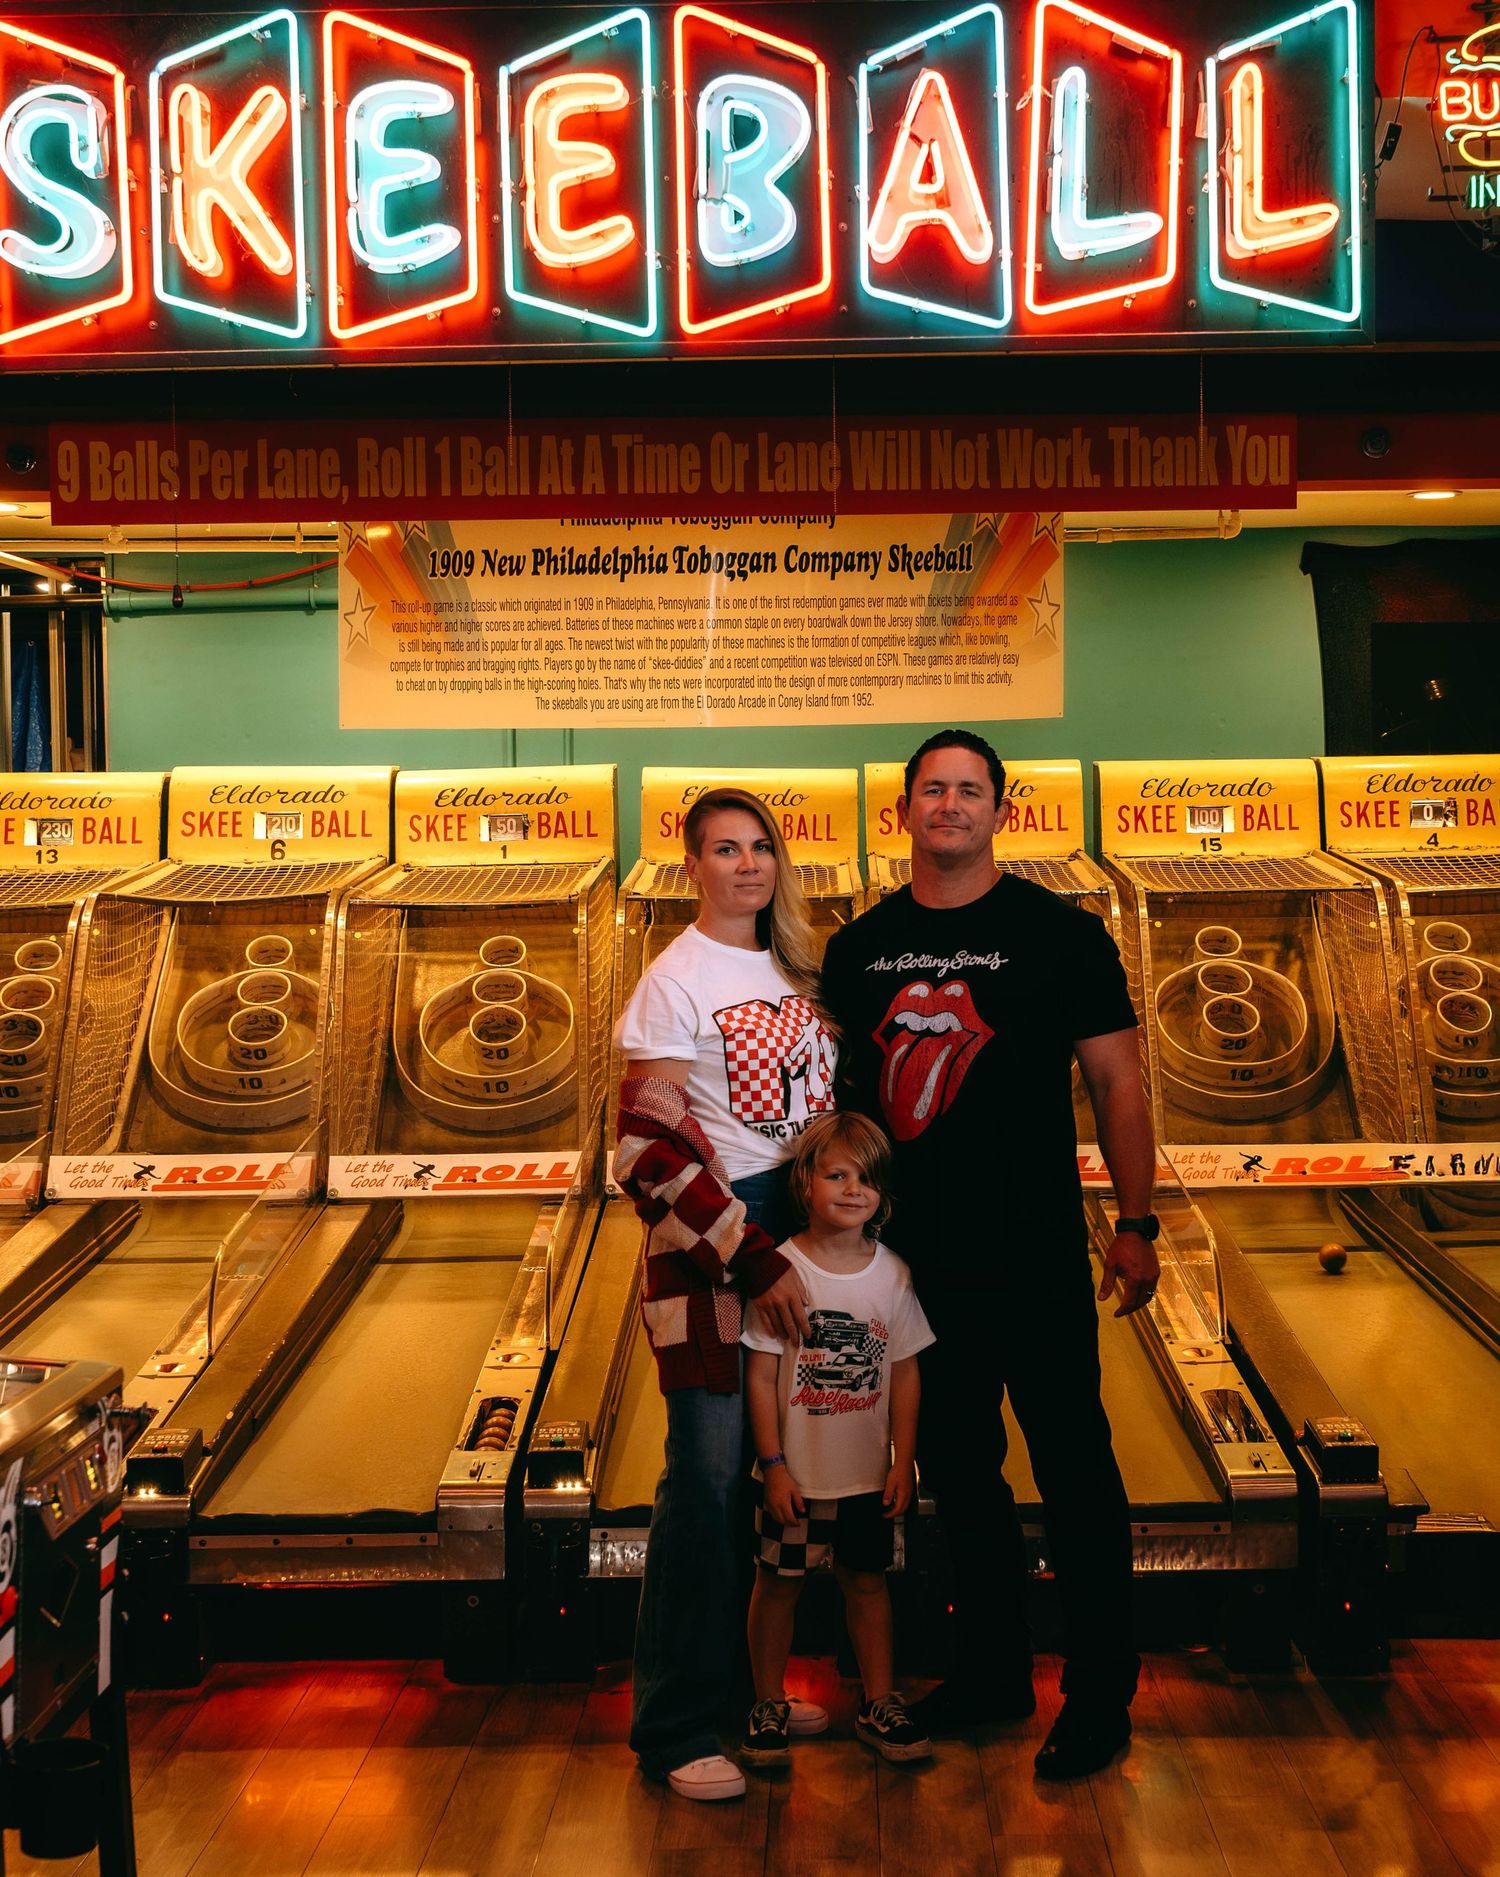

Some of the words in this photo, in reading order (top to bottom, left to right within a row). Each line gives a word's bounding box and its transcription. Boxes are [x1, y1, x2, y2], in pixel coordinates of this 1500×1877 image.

[0, 62, 1340, 279] SKEEBALL
[58, 440, 79, 502] 9
[89, 440, 180, 502] Balls
[190, 439, 247, 500] Per
[258, 439, 348, 504] Lane,
[358, 437, 426, 498] Roll
[436, 437, 450, 496] 1
[461, 436, 529, 496] Ball
[538, 436, 574, 495] At
[582, 435, 604, 494] A
[612, 434, 700, 494] Time
[710, 432, 748, 493] Or
[758, 432, 840, 492] Lane
[850, 430, 920, 490] Will
[931, 430, 990, 490] Not
[998, 428, 1100, 489] Work.
[1109, 425, 1218, 487] Thank
[1226, 424, 1289, 486] You
[429, 548, 474, 578] 1909
[481, 548, 525, 577] New
[531, 545, 668, 583] Philadelphia
[672, 544, 776, 581] Toboggan
[784, 544, 881, 580] Company
[888, 541, 972, 578] Skeeball
[390, 658, 421, 674] compete
[422, 658, 433, 671] for
[434, 658, 464, 674] trophies
[466, 658, 480, 671] and
[482, 657, 515, 674] bragging
[517, 657, 541, 673] rights.
[544, 656, 572, 673] Players
[574, 659, 585, 673] go
[586, 656, 596, 673] by
[598, 656, 611, 670] the
[613, 659, 635, 670] name
[637, 656, 646, 670] of
[709, 655, 724, 669] and
[726, 658, 731, 669] a
[733, 655, 759, 669] recent
[760, 654, 807, 671] competition
[809, 656, 826, 667] was
[828, 654, 862, 667] televised
[864, 656, 874, 667] on
[876, 652, 900, 667] ESPN.
[902, 652, 926, 666] These
[927, 654, 953, 668] games
[954, 654, 967, 665] are
[968, 651, 1001, 668] relatively
[1002, 653, 1019, 667] easy
[396, 678, 403, 691] to
[405, 678, 425, 691] cheat
[426, 680, 436, 691] on
[438, 678, 448, 694] by
[449, 678, 482, 694] dropping
[484, 677, 502, 691] balls
[504, 677, 511, 690] in
[513, 677, 525, 690] the
[527, 676, 575, 693] high-scoring
[577, 676, 601, 690] holes.
[603, 676, 627, 690] That's
[629, 676, 646, 692] why
[648, 675, 661, 689] the
[663, 676, 680, 689] nets
[682, 678, 702, 689] were
[704, 674, 754, 691] incorporated
[757, 674, 772, 688] into
[774, 674, 786, 688] the
[788, 674, 815, 690] design
[817, 673, 825, 687] of
[827, 676, 848, 687] more
[849, 673, 904, 689] contemporary
[905, 672, 942, 686] machines
[944, 672, 952, 685] to
[953, 672, 969, 684] limit
[970, 672, 984, 684] this
[986, 671, 1013, 686] activity.
[706, 694, 735, 708] Dorado
[737, 694, 766, 708] Arcade
[778, 694, 803, 710] Coney
[805, 693, 828, 707] Island
[1140, 777, 1277, 799] Eldorado
[1366, 773, 1496, 794] Eldorado
[0, 791, 114, 810] ldorado
[209, 784, 349, 804] Eldorado
[434, 786, 572, 808] Eldorado
[1009, 804, 1069, 833] BALL
[1118, 805, 1177, 833] SKEE
[1243, 804, 1300, 832] BALL
[1194, 810, 1219, 825] 100
[1340, 801, 1400, 828] SKEE
[1423, 805, 1434, 821] 0
[41, 822, 72, 838] 230
[82, 816, 143, 845] BALL
[181, 811, 243, 838] SKEE
[311, 810, 373, 837] BALL
[271, 817, 296, 832] 210
[409, 814, 467, 842] SKEE
[537, 810, 598, 838] BALL
[495, 818, 517, 833] 50
[783, 814, 837, 841] BALL
[1200, 838, 1222, 852] 15
[1427, 833, 1439, 847] 4
[36, 849, 58, 864] 13
[271, 839, 286, 860] 6
[500, 845, 507, 859] 1
[892, 953, 951, 977] Rolling
[950, 950, 1008, 970] Stones
[1221, 1038, 1247, 1050] 20
[240, 1047, 267, 1060] 20
[482, 1047, 509, 1060] 20
[239, 1077, 263, 1089] 10
[1231, 1069, 1254, 1081] 10
[483, 1081, 509, 1093] 10
[1173, 1152, 1197, 1164] Let
[1200, 1152, 1221, 1164] the
[64, 1162, 89, 1174] Let
[91, 1161, 115, 1173] the
[345, 1161, 370, 1173] Let
[373, 1160, 394, 1172] the
[442, 1162, 575, 1183] ROLL
[1182, 1166, 1216, 1180] Good
[1222, 1166, 1260, 1179] Times
[69, 1175, 108, 1189] Good
[112, 1174, 151, 1188] Times
[351, 1174, 389, 1189] Good
[393, 1174, 431, 1187] Times
[870, 1318, 887, 1331] FULL
